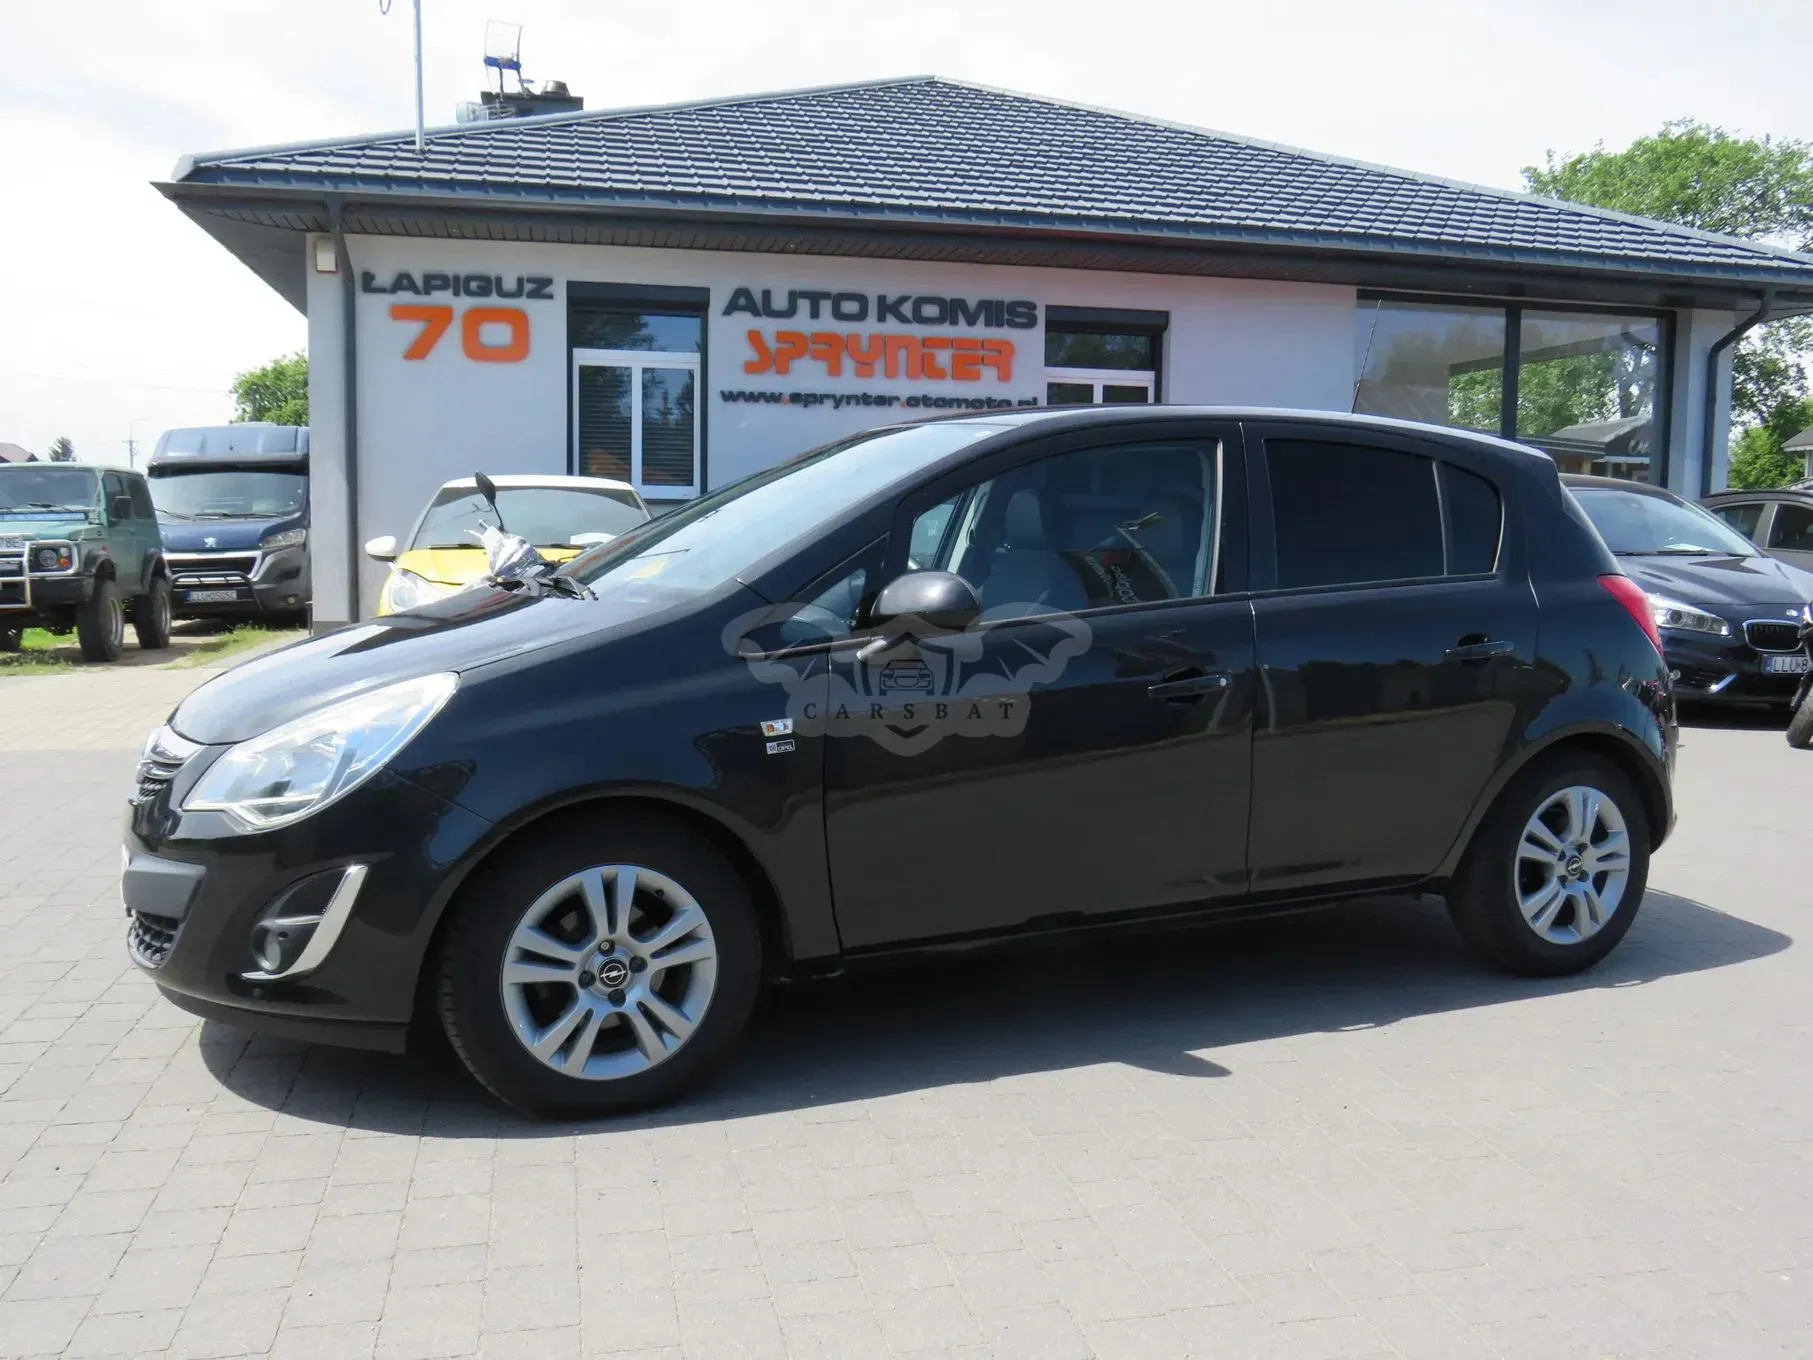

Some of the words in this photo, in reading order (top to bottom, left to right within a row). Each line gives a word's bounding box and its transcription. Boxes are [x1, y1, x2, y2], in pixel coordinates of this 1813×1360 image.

[361, 271, 554, 300] ŁAPIGUZ
[722, 287, 869, 322] AUTO
[876, 294, 1038, 329] KOMIS
[388, 304, 530, 364] 70
[743, 329, 1015, 383] SPRYNTER
[720, 390, 1038, 410] www.sprynter.otomotol
[1773, 658, 1797, 673] LLU
